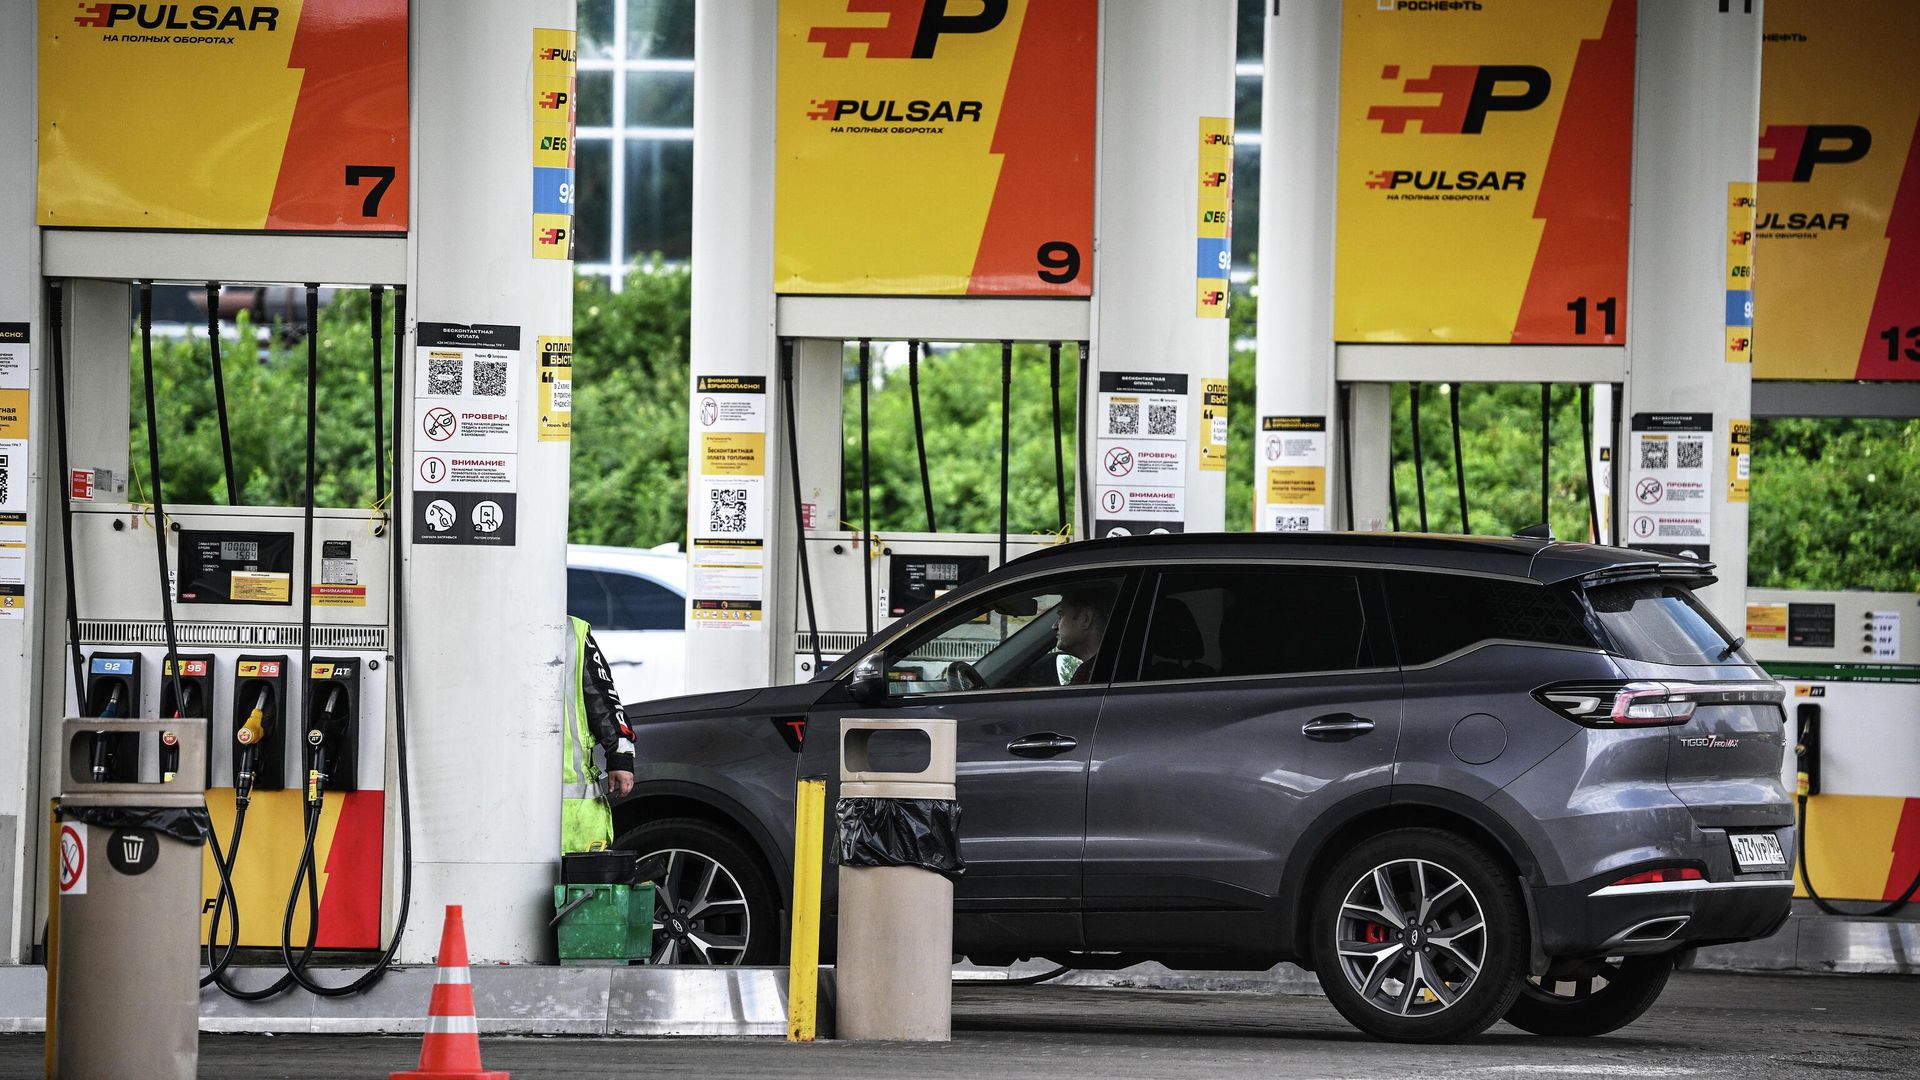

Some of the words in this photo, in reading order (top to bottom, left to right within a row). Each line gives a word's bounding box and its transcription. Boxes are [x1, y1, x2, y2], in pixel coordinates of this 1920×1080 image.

[1398, 0, 1482, 10] РОСНЕФТЬ
[107, 4, 279, 31] PULSAR
[556, 92, 567, 109] P
[1460, 65, 1552, 134] P
[834, 100, 982, 122] PULSAR
[1792, 125, 1872, 182] P
[1216, 172, 1226, 187] P
[1390, 171, 1526, 190] PULSAR
[346, 165, 396, 218] 7
[555, 229, 566, 244] P
[1742, 232, 1751, 245] P
[1037, 241, 1081, 284] 9
[1215, 292, 1224, 305] P
[1567, 297, 1616, 335] 11
